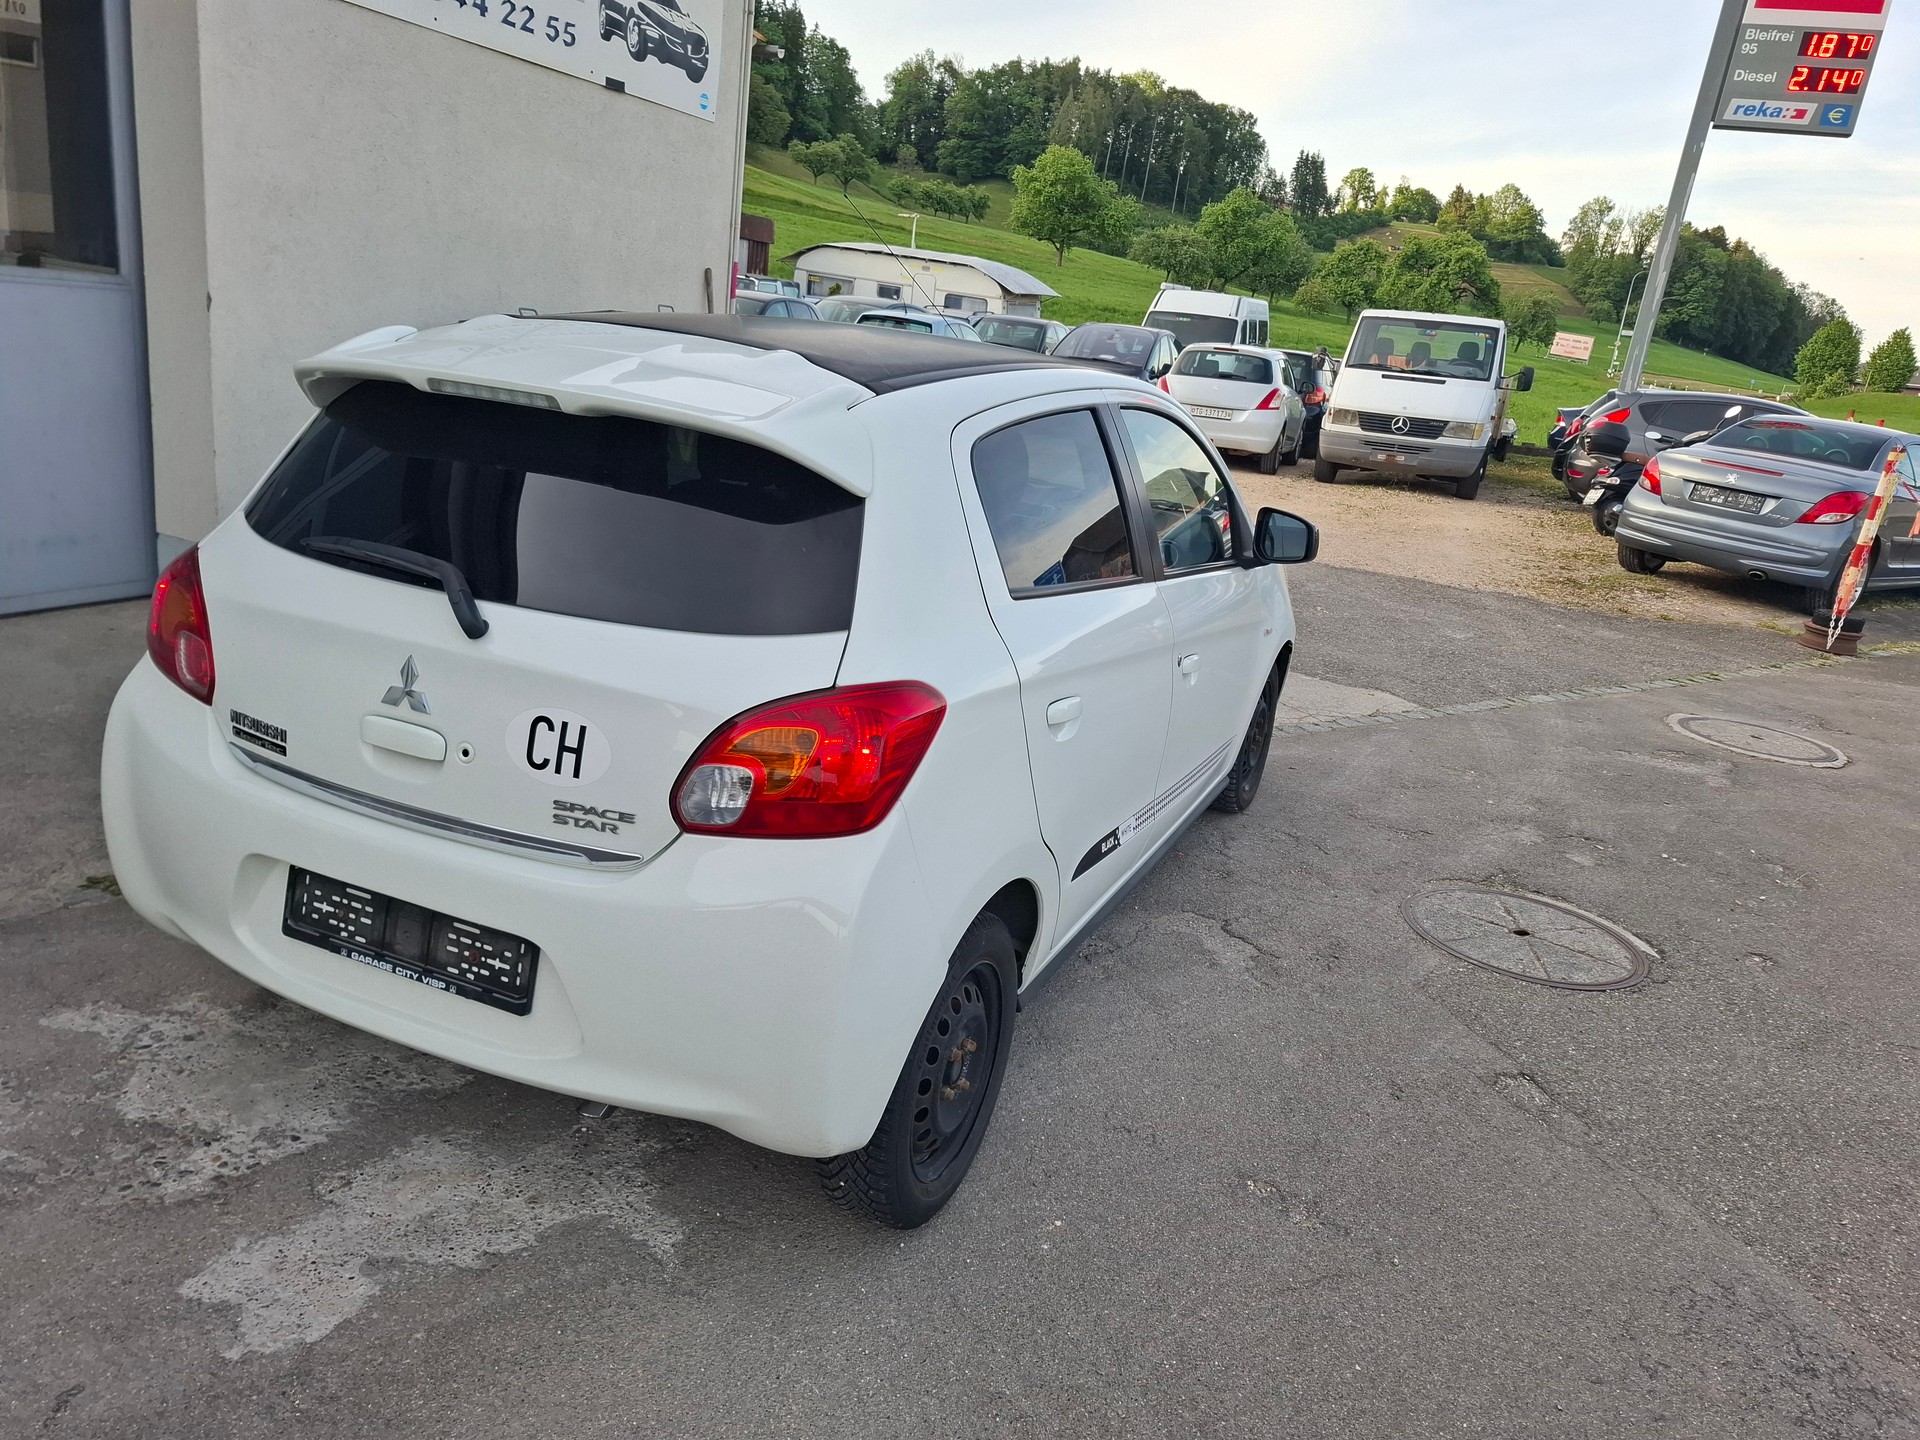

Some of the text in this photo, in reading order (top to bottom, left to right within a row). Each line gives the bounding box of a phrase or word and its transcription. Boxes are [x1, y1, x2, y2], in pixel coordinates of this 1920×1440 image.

[501, 0, 535, 35] 22
[545, 15, 576, 47] 55
[1744, 28, 1795, 42] Bleifrei
[1740, 43, 1758, 55] 95
[1733, 69, 1777, 83] Diesel
[230, 708, 288, 744] MITSUBISHI
[526, 714, 588, 780] CH
[553, 800, 636, 825] SPACE
[553, 813, 619, 835] STAR
[1101, 836, 1114, 853] BLACK
[351, 952, 446, 989] GARAGE CITY VISP
